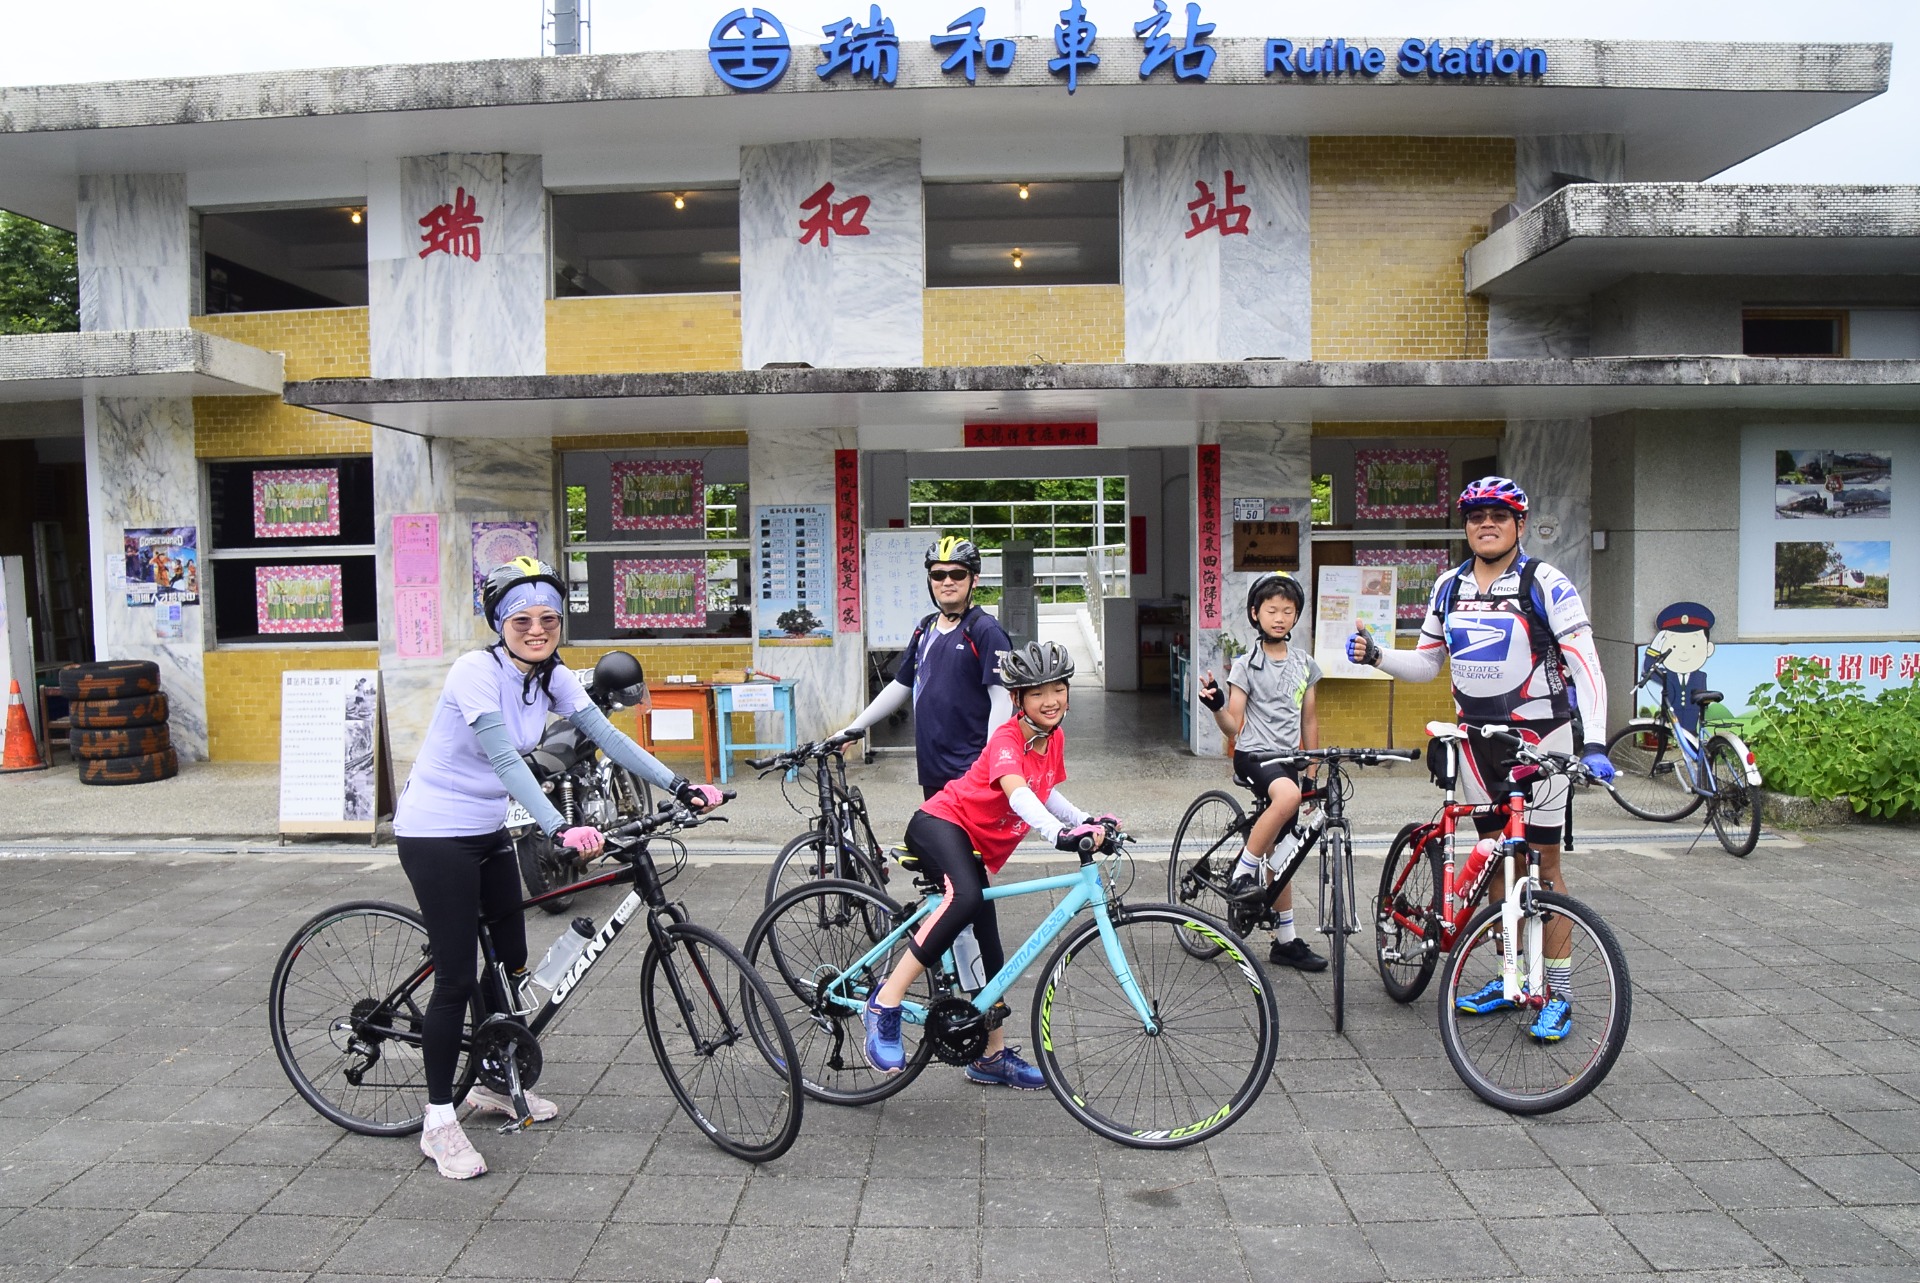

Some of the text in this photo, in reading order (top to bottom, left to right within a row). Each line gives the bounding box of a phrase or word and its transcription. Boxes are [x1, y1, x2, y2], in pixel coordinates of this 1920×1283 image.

[816, 0, 1218, 94] 瑞和車站
[1265, 39, 1548, 78] Ruihe Station
[418, 187, 484, 262] 瑞
[799, 182, 871, 247] 和
[1184, 170, 1252, 239] 站
[1246, 510, 1258, 520] 50
[1466, 672, 1504, 680] SERVICE
[1467, 665, 1500, 673] STATES
[551, 914, 617, 1005] GIANT
[997, 908, 1066, 987] PRIMAVERA
